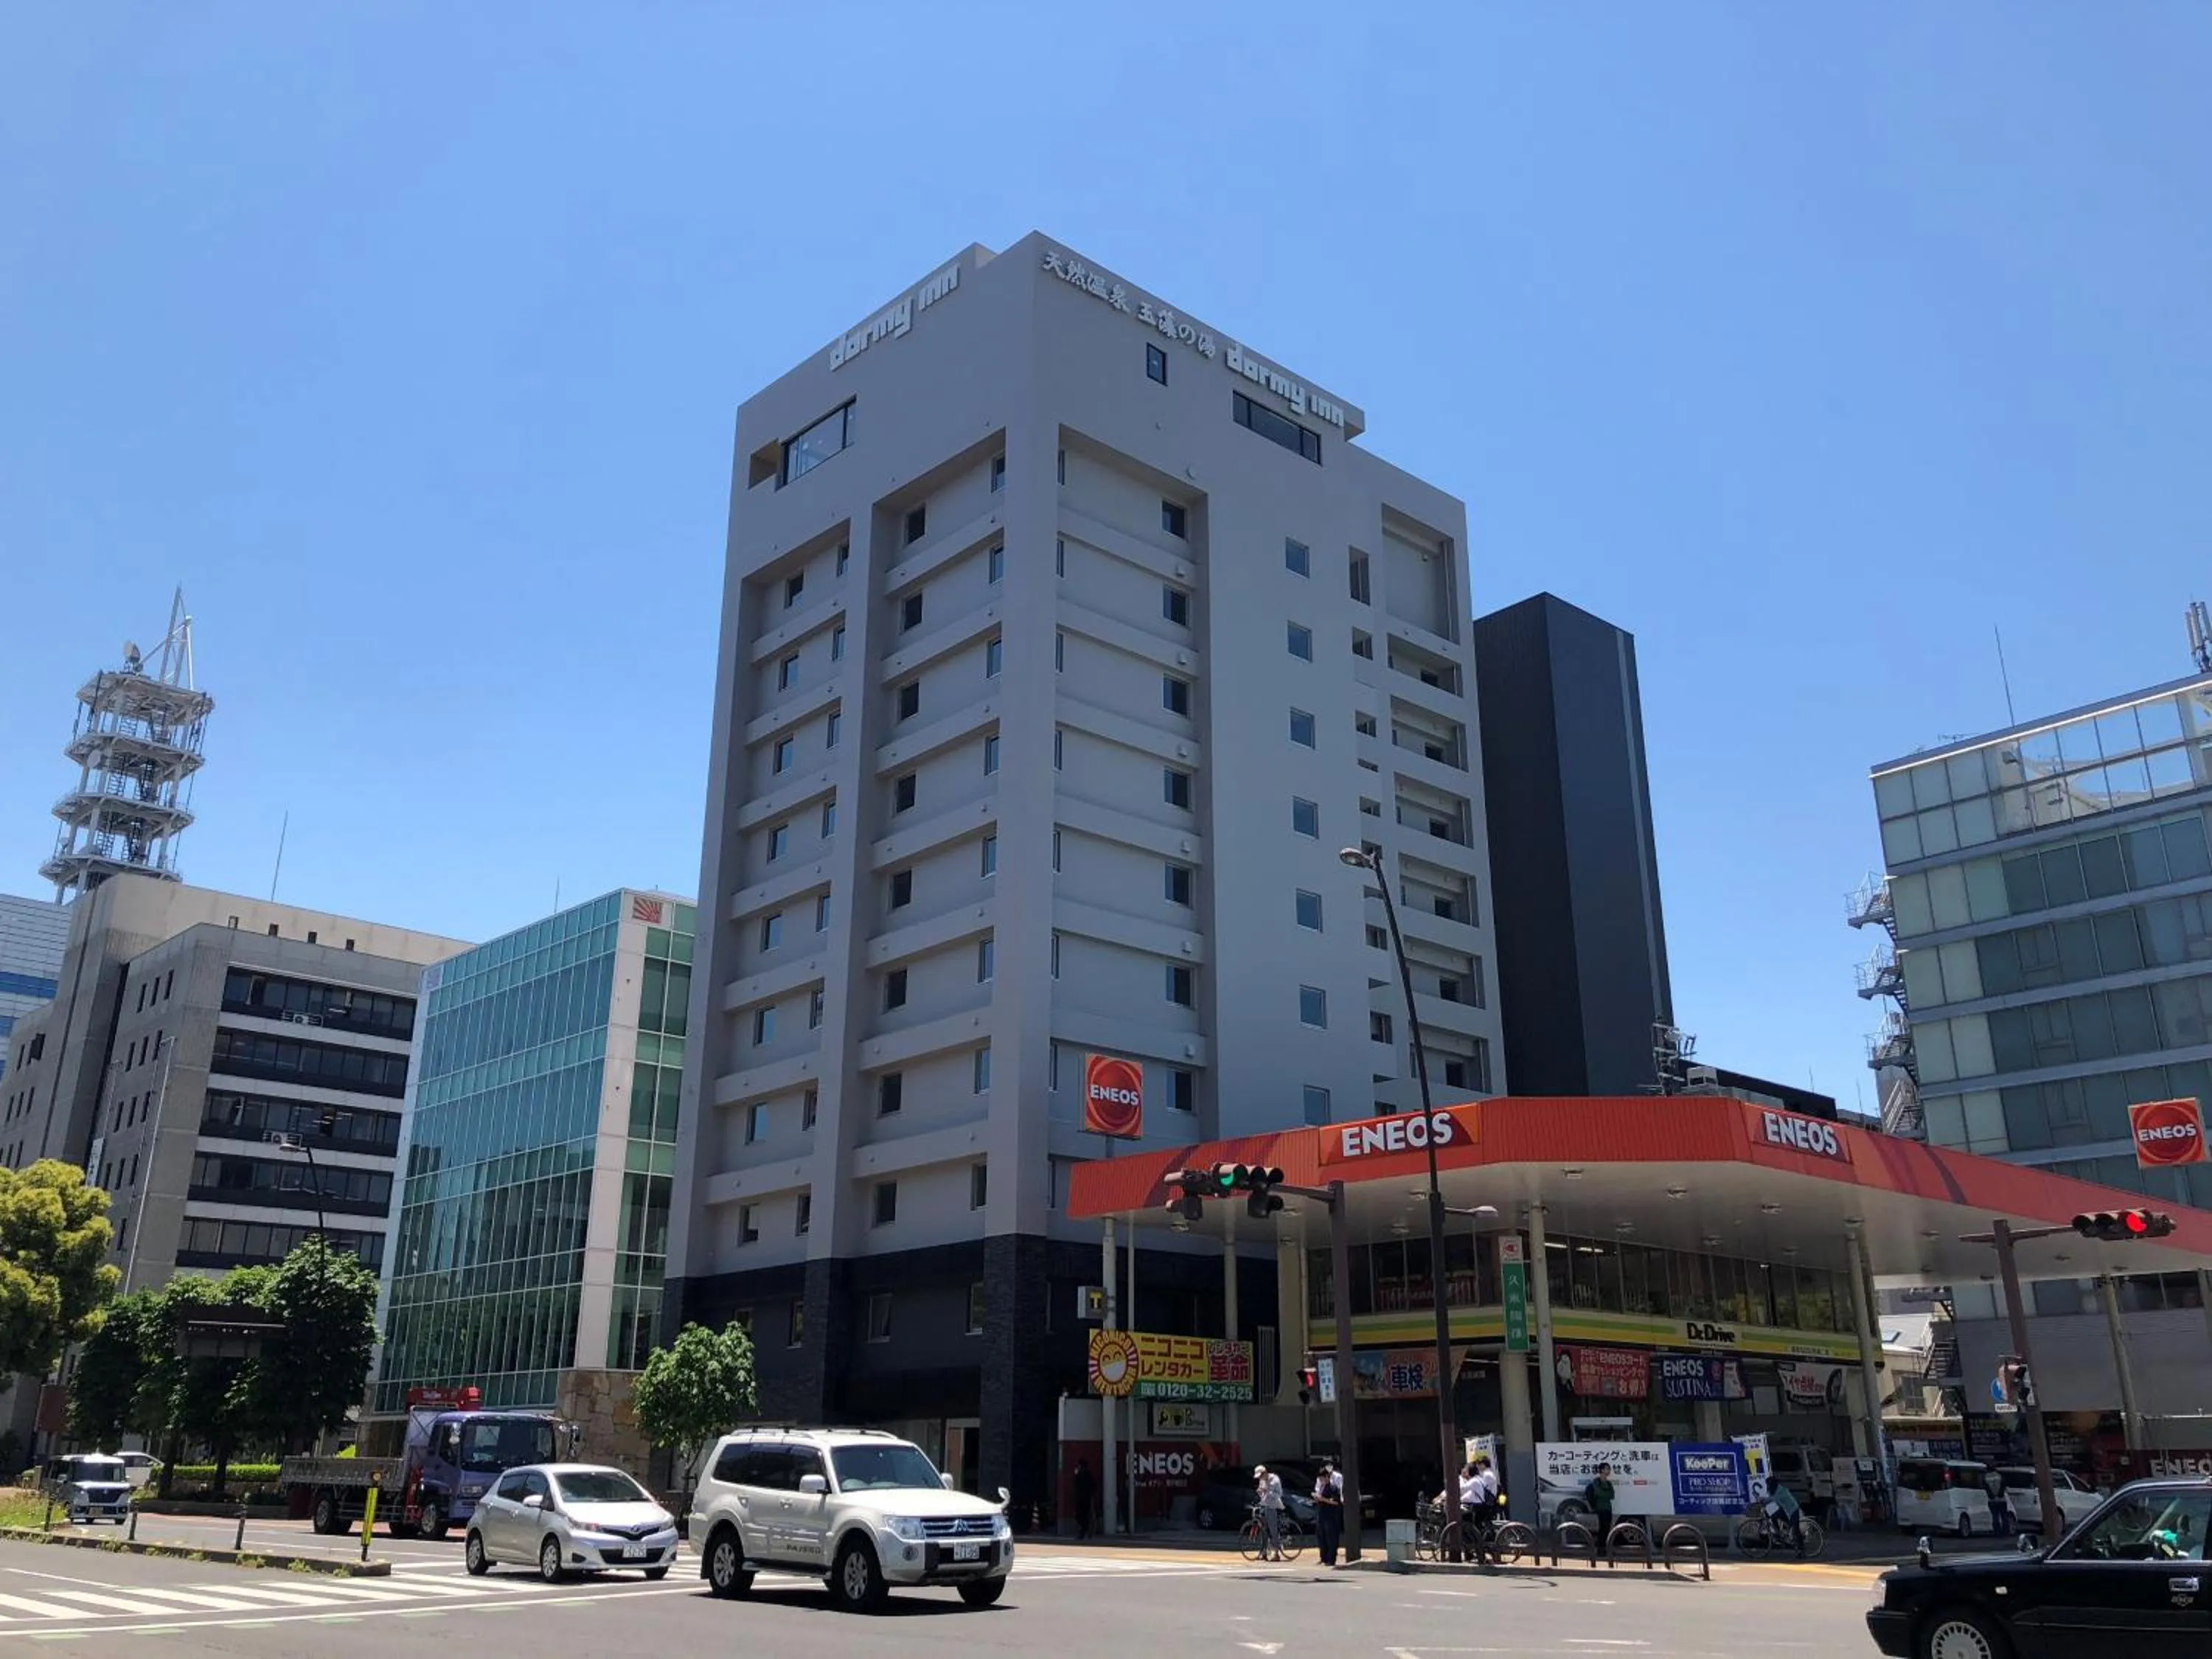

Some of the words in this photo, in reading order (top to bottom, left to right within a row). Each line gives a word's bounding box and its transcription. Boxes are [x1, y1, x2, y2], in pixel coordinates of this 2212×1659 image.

[1042, 251, 1130, 314] 天然温泉
[829, 295, 914, 373] dormy
[918, 265, 960, 312] inn
[1226, 343, 1307, 416] dormy
[1310, 394, 1344, 428] inn
[1090, 1084, 1139, 1106] ENEOS
[1342, 1112, 1453, 1157] ENEOS
[1763, 1111, 1837, 1155] ENEOS
[2138, 1122, 2197, 1141] ENEOS
[1140, 1335, 1204, 1360] ニコニコ
[1140, 1359, 1204, 1378] レンタカー
[1210, 1354, 1249, 1381] 革命
[1390, 1363, 1424, 1392] 車検
[1663, 1359, 1705, 1377] ENEOS
[1666, 1377, 1712, 1399] SUSTINA
